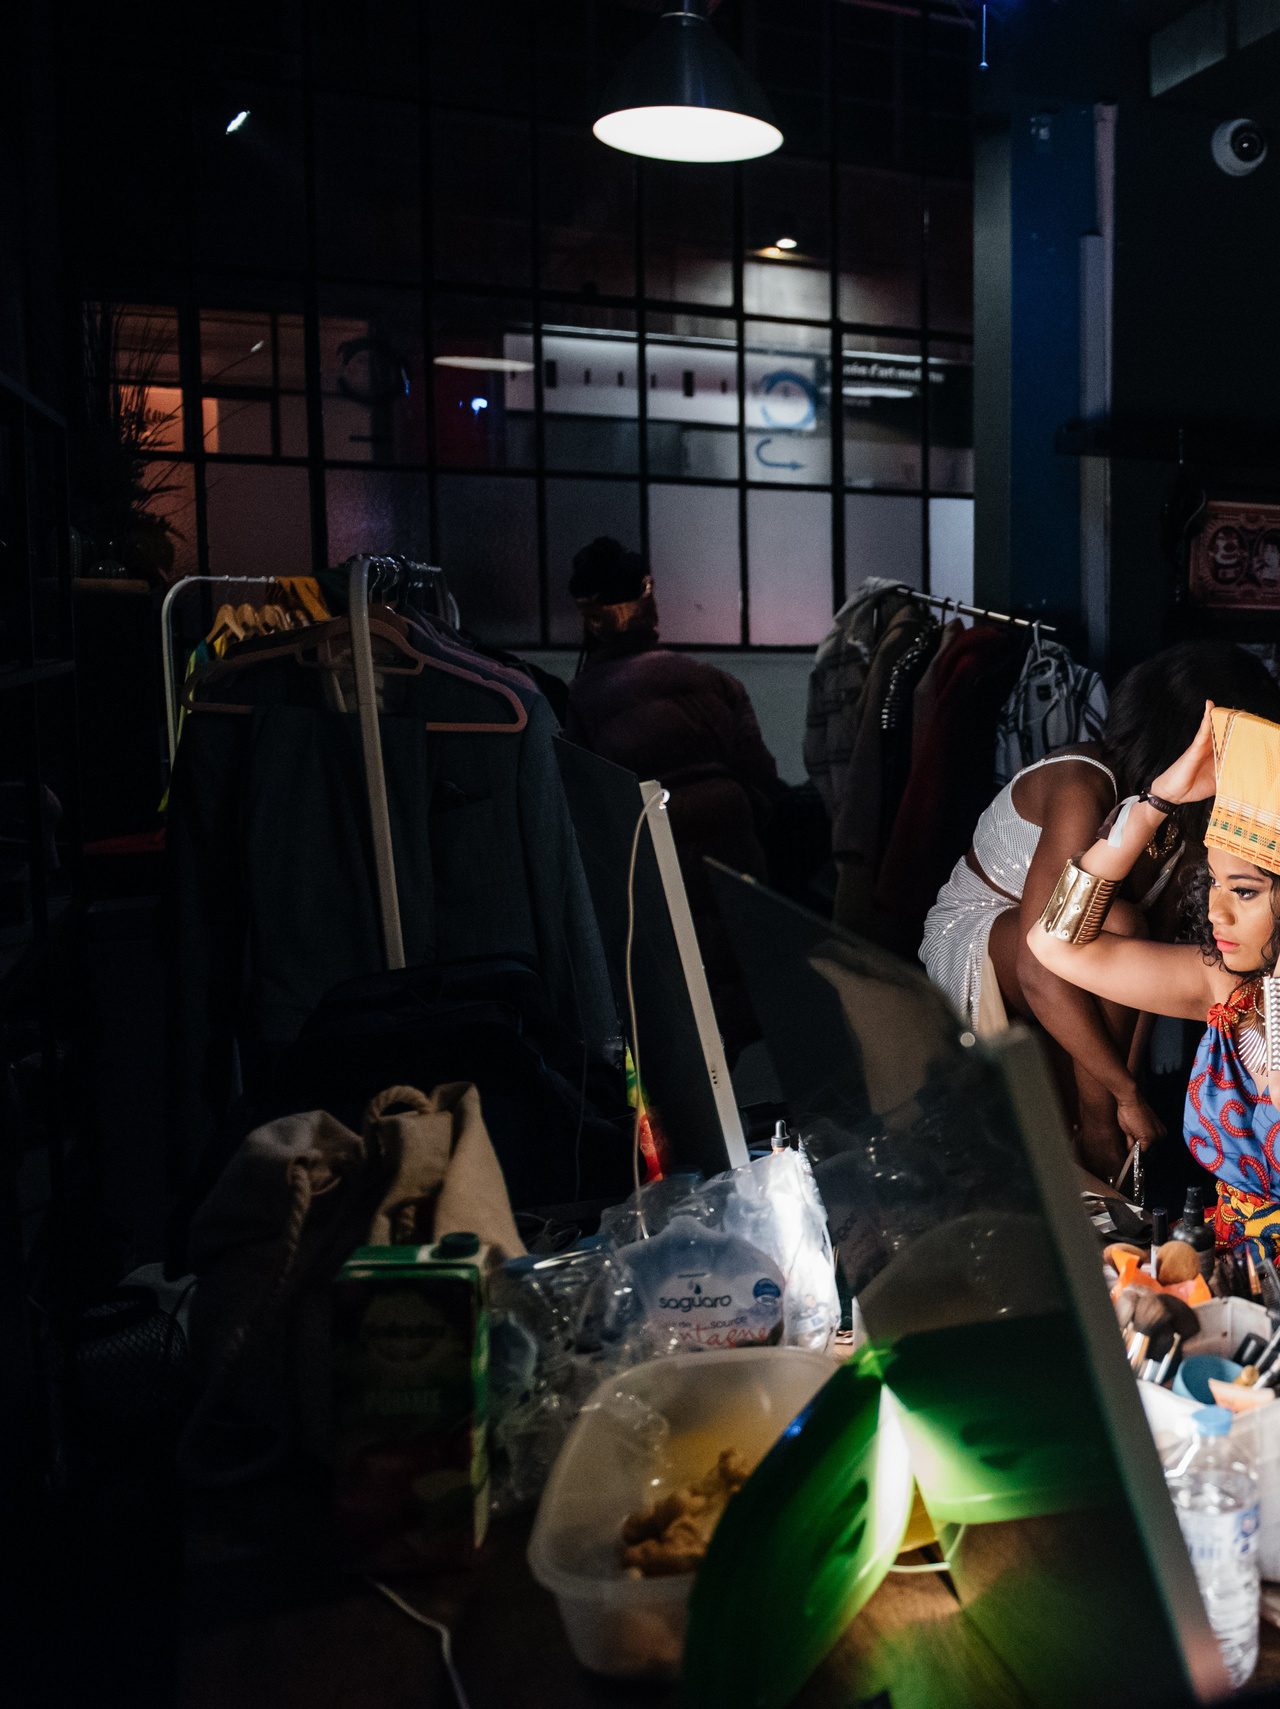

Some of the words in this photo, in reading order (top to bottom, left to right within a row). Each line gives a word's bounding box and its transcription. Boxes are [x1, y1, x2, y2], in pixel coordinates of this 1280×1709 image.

[658, 1295, 732, 1312] saguaro
[709, 1316, 748, 1329] source
[679, 1325, 769, 1348] ntagne
